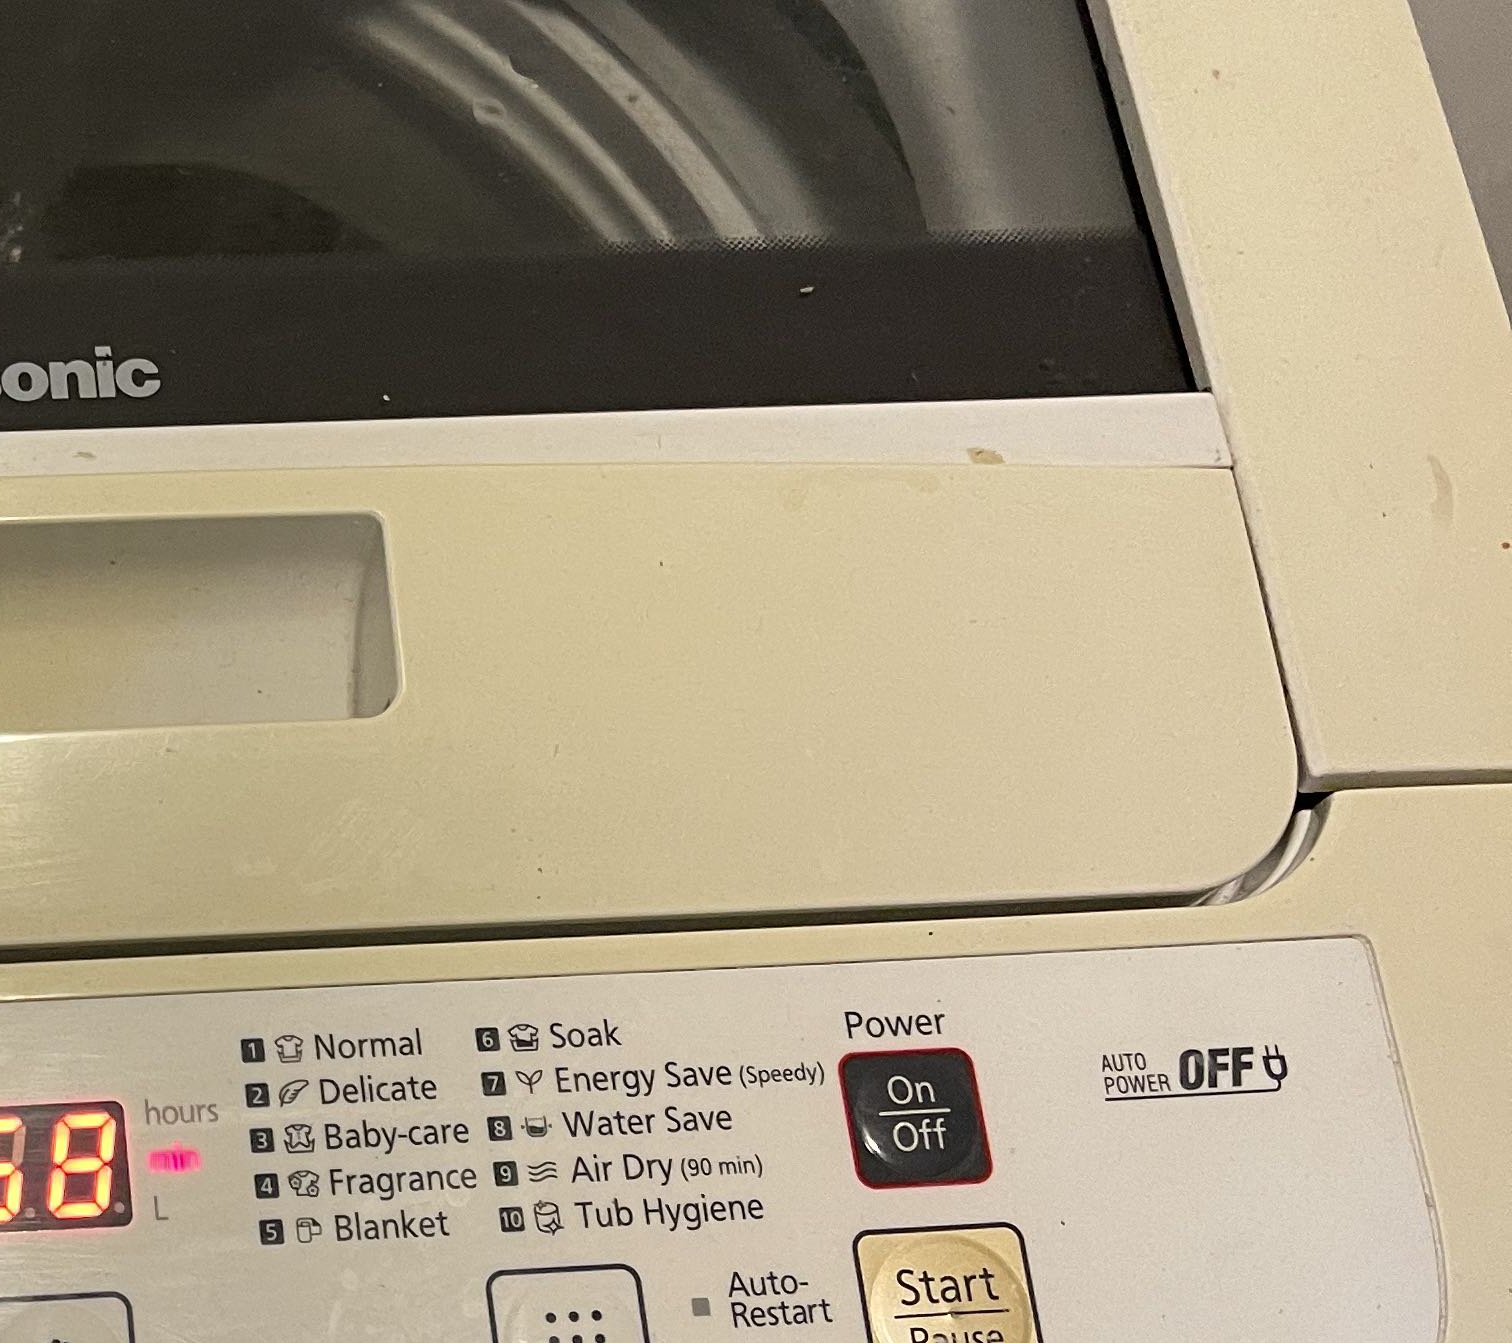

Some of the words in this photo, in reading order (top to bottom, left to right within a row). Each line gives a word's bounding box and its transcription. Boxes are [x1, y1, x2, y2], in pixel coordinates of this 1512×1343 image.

[549, 1018, 623, 1049] Soak
[843, 1011, 946, 1039] Power
[314, 1027, 423, 1061] Normal
[554, 1066, 655, 1098] Energy
[664, 1061, 732, 1088] Save
[739, 1060, 825, 1089] (Speedy)
[1102, 1054, 1147, 1073] AUTO
[1179, 1047, 1253, 1089] OFF
[1105, 1074, 1171, 1094] POWER
[319, 1074, 437, 1105] Delicate
[887, 1075, 936, 1105] On
[145, 1099, 219, 1125] hours
[561, 1110, 656, 1138] Water
[664, 1105, 733, 1133] Save
[324, 1119, 469, 1155] Baby-care
[892, 1120, 946, 1152] Off
[329, 1168, 477, 1201] Fragrance
[571, 1153, 613, 1184] Air
[622, 1153, 673, 1187] Dry
[680, 1157, 713, 1182] (90
[718, 1153, 763, 1179] min)
[155, 1197, 169, 1221] L
[574, 1197, 634, 1229] Tub
[642, 1193, 764, 1232] Hygiene
[334, 1209, 450, 1242] Blanket
[728, 1271, 808, 1298] Auto-
[896, 1267, 1000, 1306] Start
[730, 1297, 832, 1327] Restart
